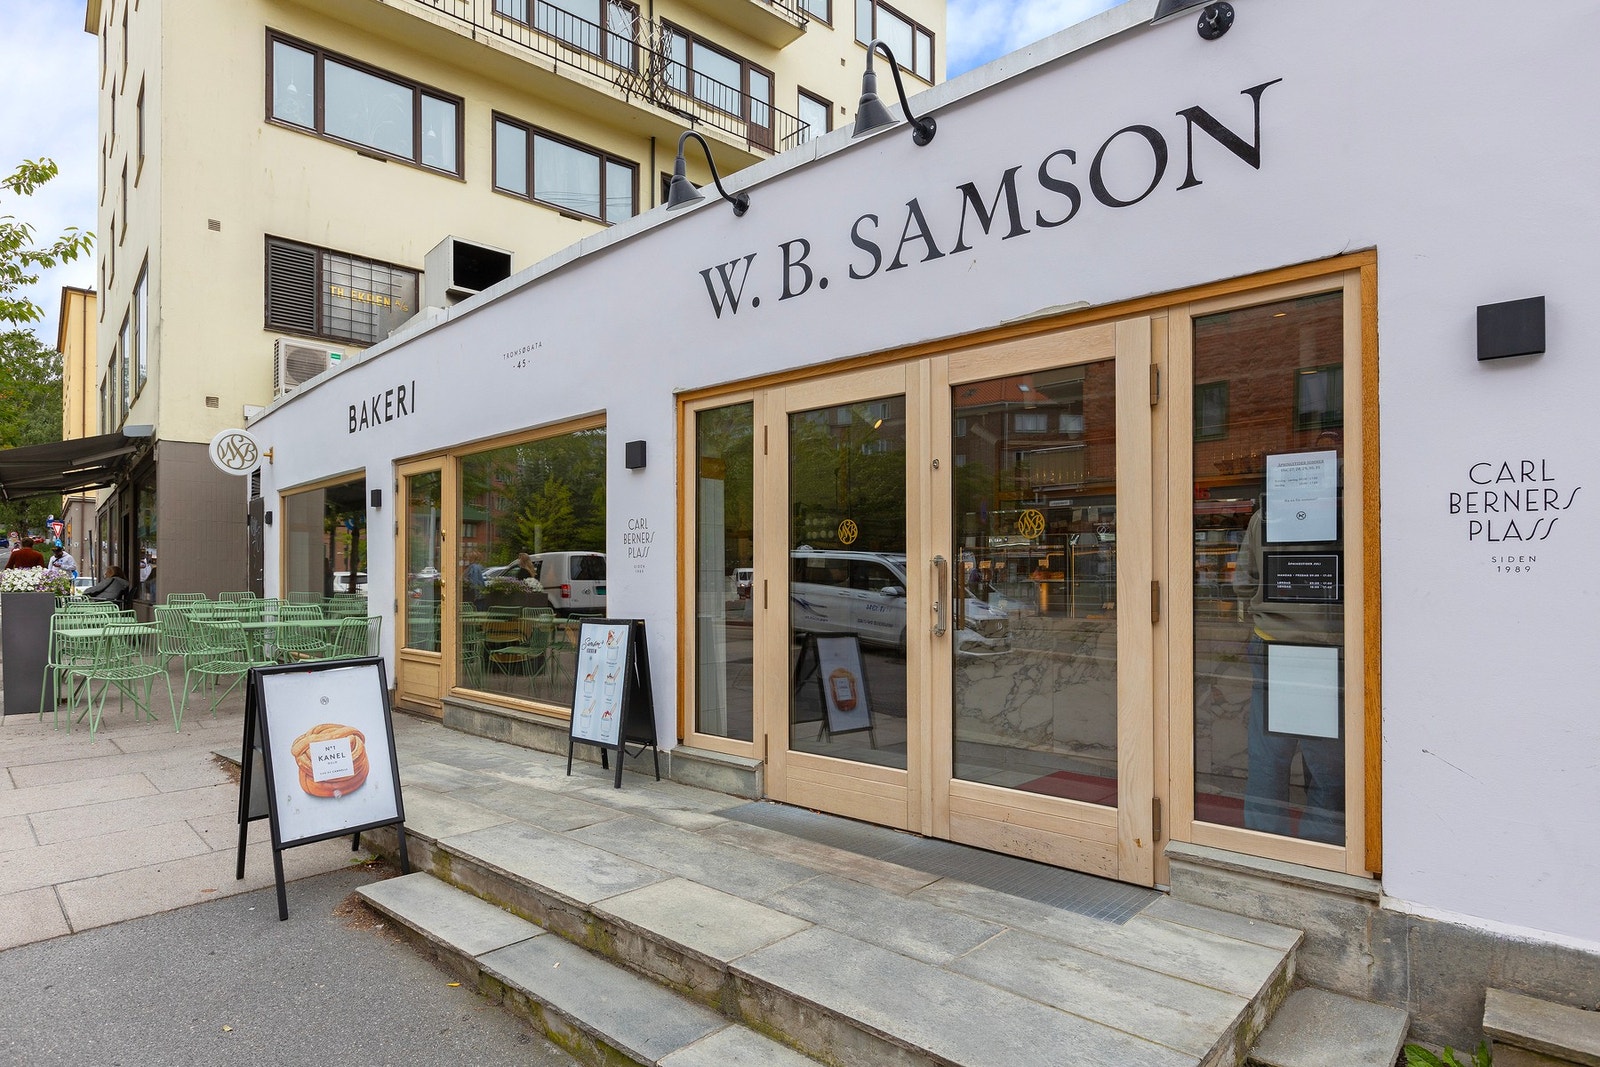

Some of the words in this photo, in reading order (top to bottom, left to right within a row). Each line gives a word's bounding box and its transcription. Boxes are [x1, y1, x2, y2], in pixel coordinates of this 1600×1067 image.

[698, 252, 760, 319] W.
[777, 238, 829, 301] B.
[848, 77, 1284, 281] SAMSON
[349, 380, 415, 434] BAKERI
[1469, 458, 1555, 485] CARL
[1450, 486, 1582, 515] BERNERS
[628, 517, 648, 531] CARL
[1469, 517, 1559, 542] PLASS
[623, 531, 656, 545] BERNERS
[628, 546, 650, 559] PLASS
[1491, 555, 1537, 563] SIDEN
[1497, 565, 1532, 574] 1989
[318, 752, 346, 762] KANEL
